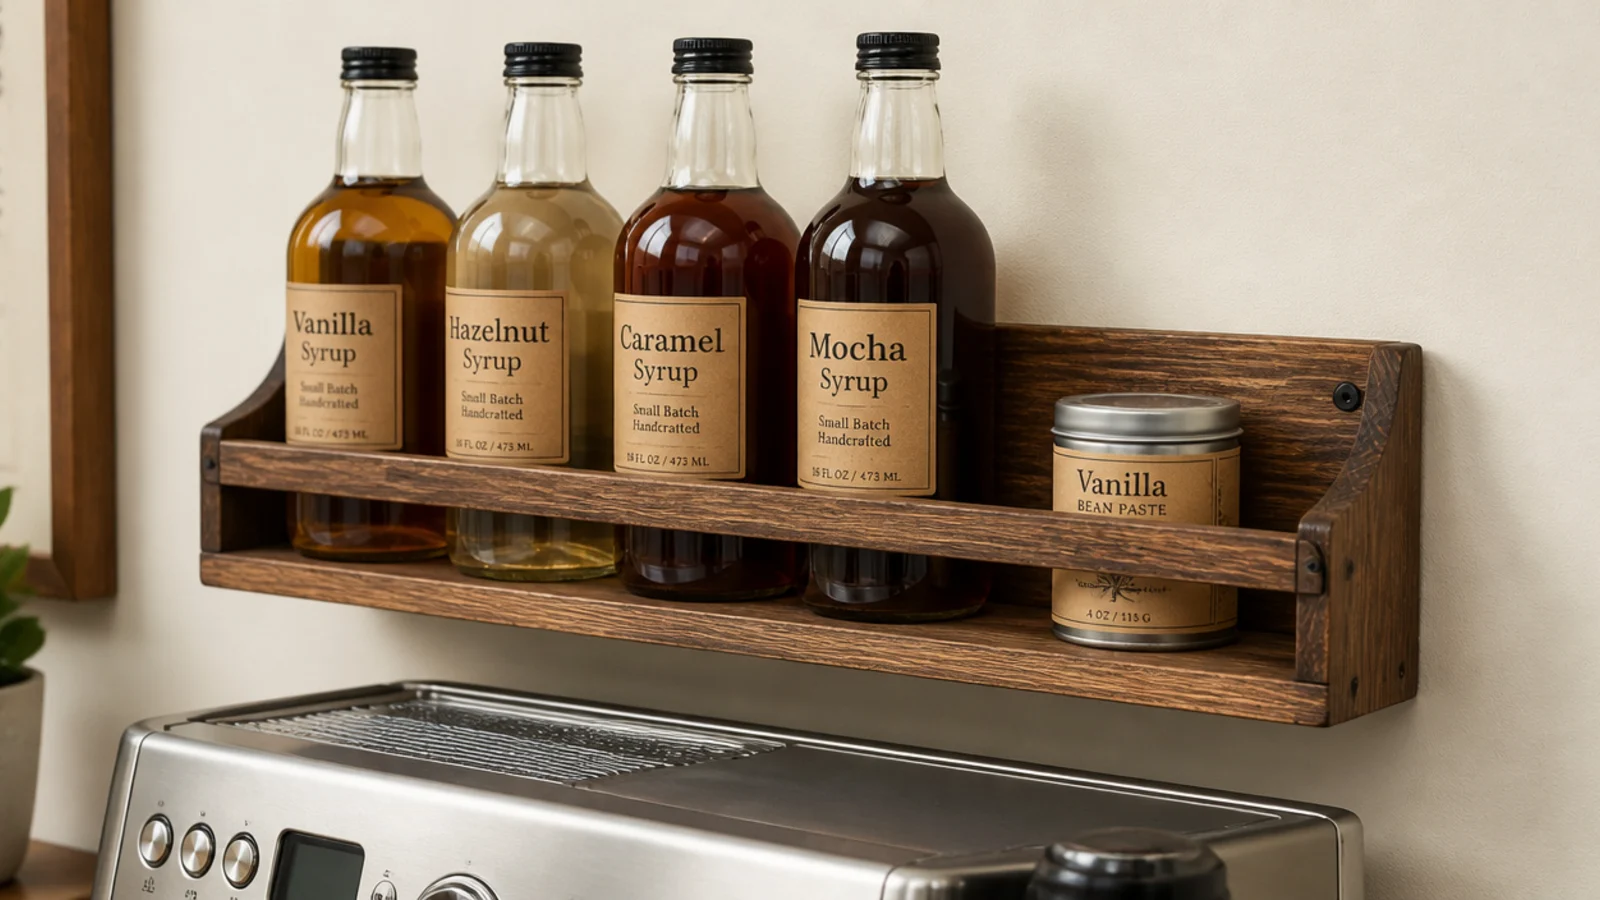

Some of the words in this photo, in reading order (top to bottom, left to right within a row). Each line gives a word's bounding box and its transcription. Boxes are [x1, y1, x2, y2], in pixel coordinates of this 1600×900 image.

[293, 310, 372, 336] Vanilla
[449, 316, 550, 344] Hazelnut
[620, 324, 725, 353] Caramel
[809, 332, 907, 362] Mocha
[301, 340, 356, 369] Syrup
[463, 348, 522, 376] Syrup
[633, 358, 698, 388] Syrup
[327, 383, 358, 395] Batch
[820, 368, 888, 398] Syrup
[490, 393, 524, 405] Batch
[663, 405, 699, 418] Batch
[818, 415, 849, 429] Small
[853, 417, 890, 430] Batch
[464, 440, 473, 449] FL
[475, 440, 488, 450] OZ
[489, 441, 495, 451] /
[517, 443, 533, 451] ML
[818, 431, 892, 447] Handcrafted
[635, 453, 645, 463] FL
[647, 454, 660, 465] OZ
[662, 456, 668, 466] /
[669, 457, 688, 466] 473
[691, 457, 709, 466] ML
[822, 468, 832, 478] FL
[834, 470, 850, 480] OZ
[851, 470, 856, 482] /
[860, 472, 880, 482] 473
[883, 472, 902, 482] ML
[1077, 469, 1168, 497] Vanilla
[1077, 499, 1113, 514] BEAN
[1119, 503, 1167, 516] PASTE
[1096, 610, 1110, 620] OZ
[1112, 611, 1117, 622] /
